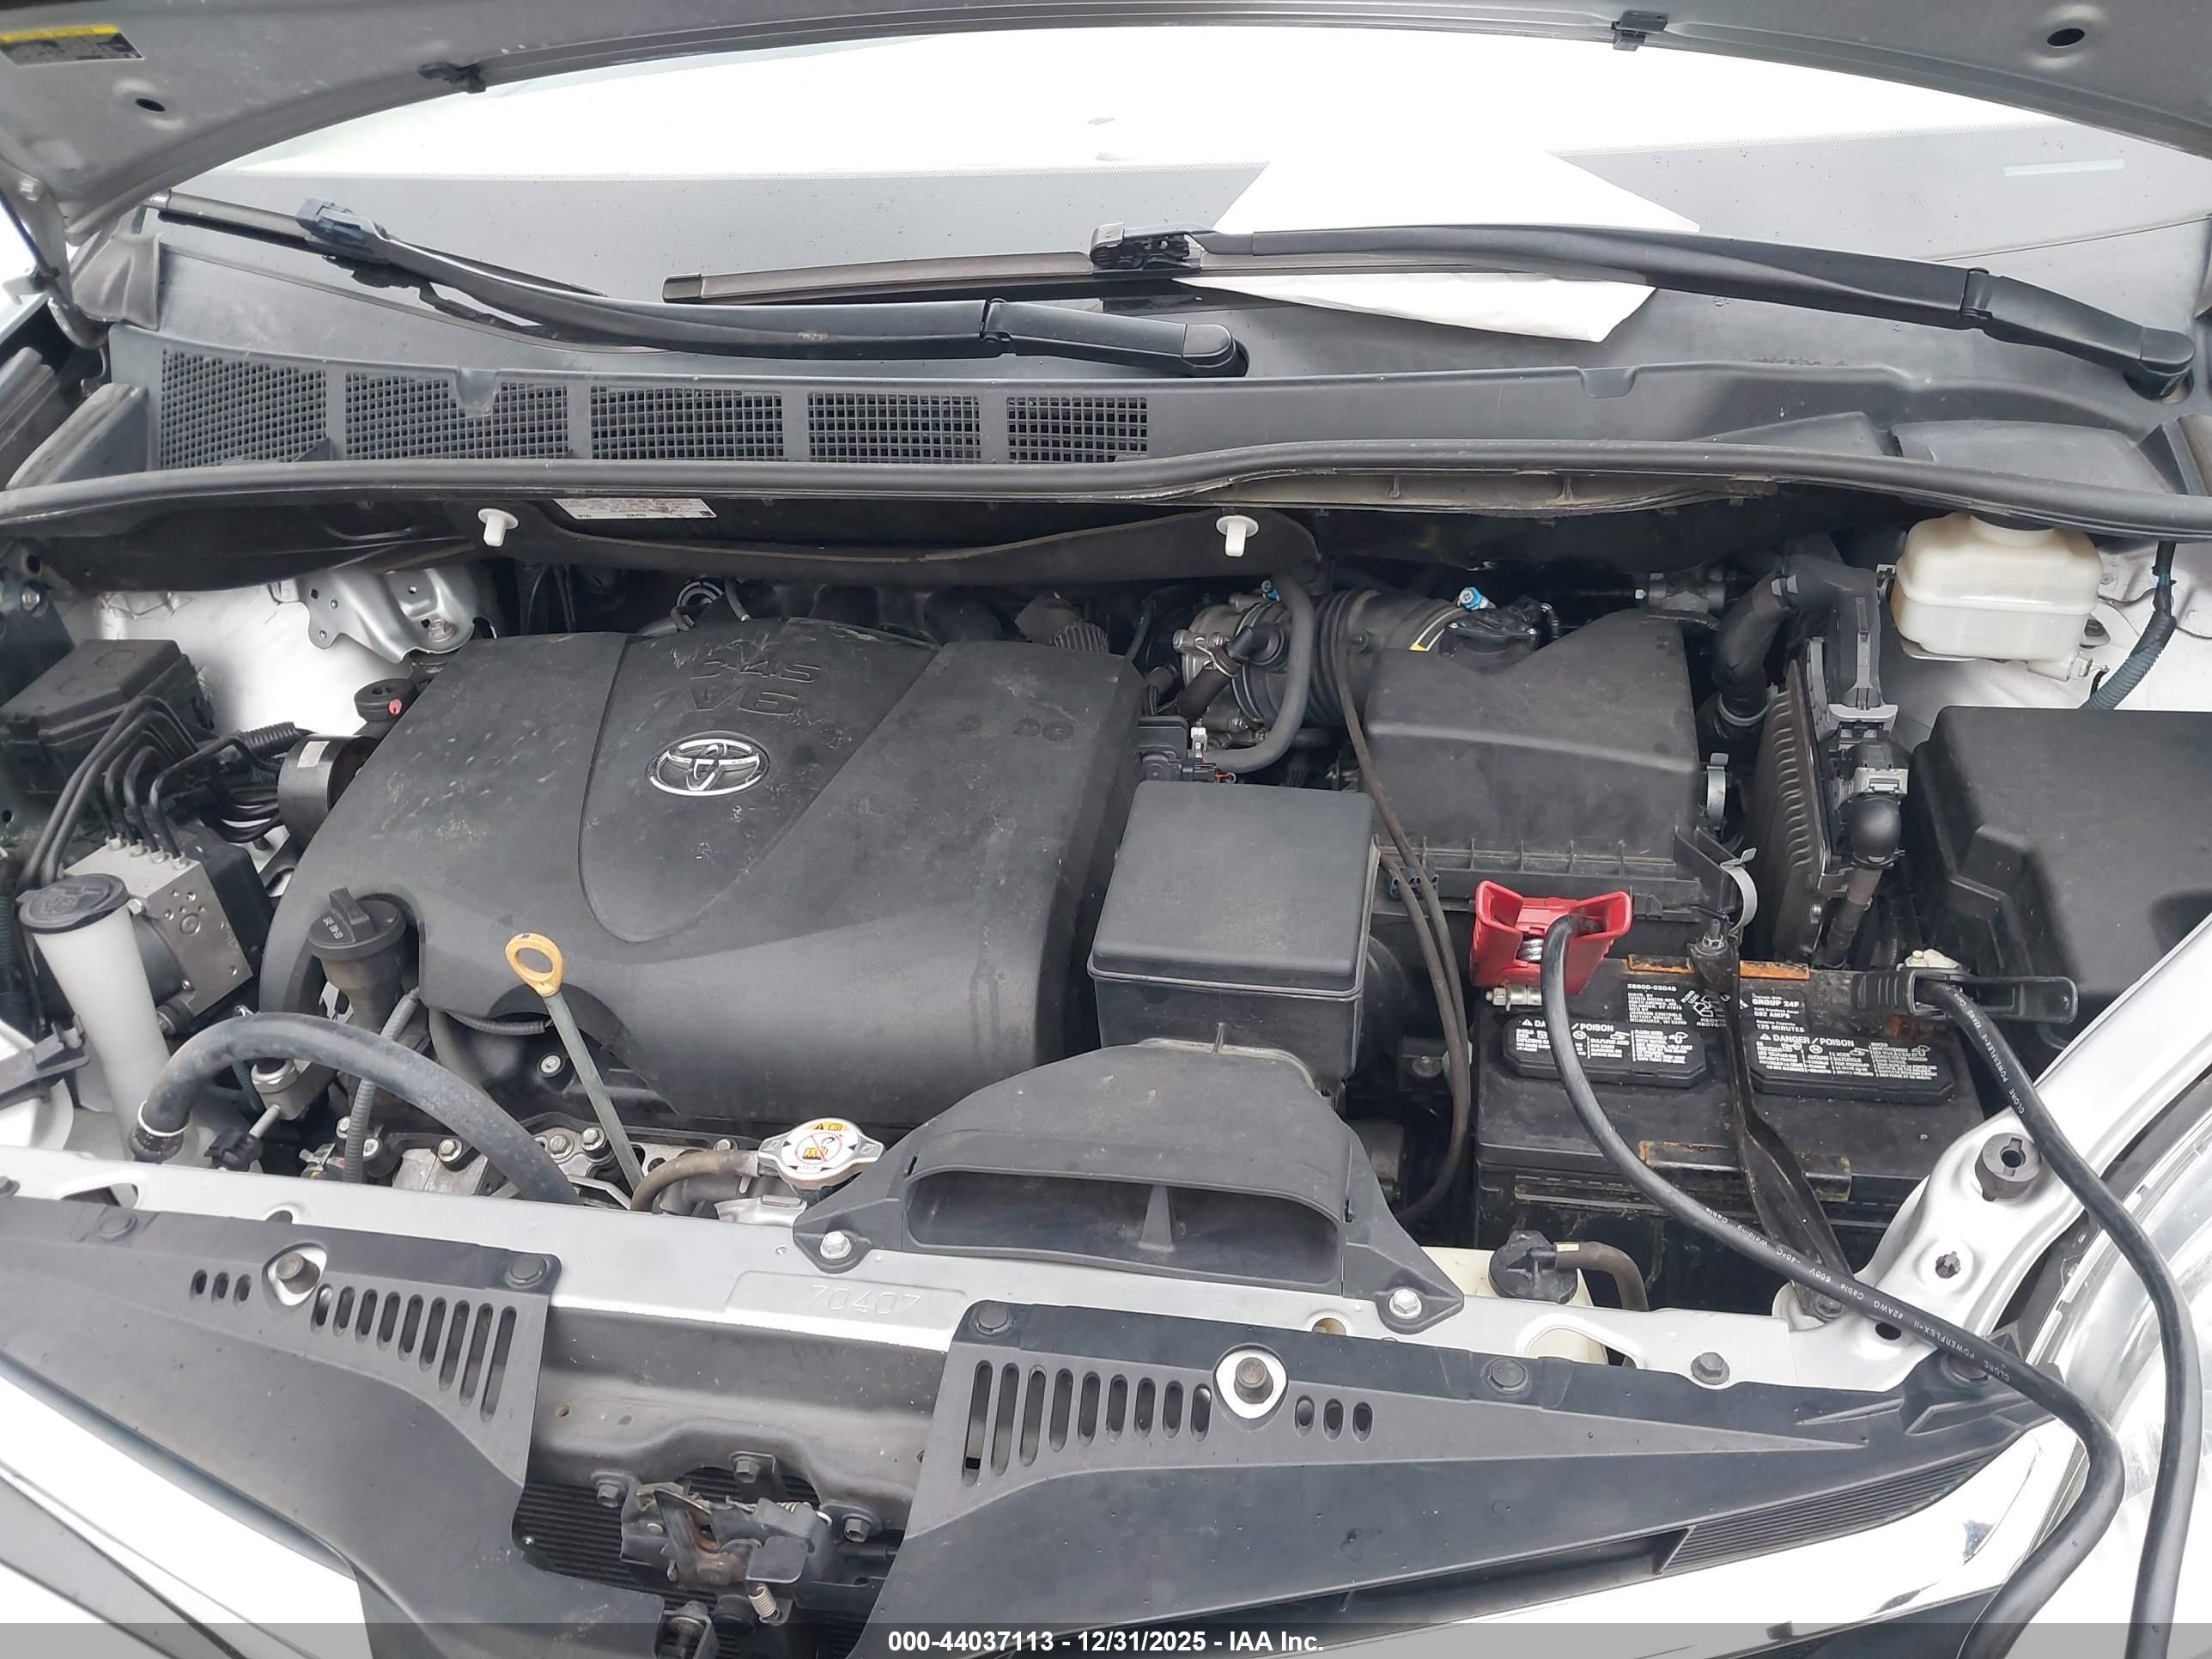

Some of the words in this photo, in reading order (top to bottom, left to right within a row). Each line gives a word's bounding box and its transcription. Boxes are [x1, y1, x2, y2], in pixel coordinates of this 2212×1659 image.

[687, 685, 799, 717] V6
[1579, 1023, 1614, 1032] POISON
[1772, 1034, 1810, 1044] DANGER
[1819, 1038, 1855, 1047] POISON
[2008, 1086, 2025, 1115] CLORE
[1705, 1206, 1729, 1224] Cable
[1736, 1224, 1768, 1248] Welding
[1809, 1267, 1832, 1284] 600V
[809, 1284, 922, 1315] 70407
[1840, 1283, 1864, 1300] Cable
[1873, 1299, 1904, 1320] #2AWG
[1984, 1359, 2010, 1382] CLORE
